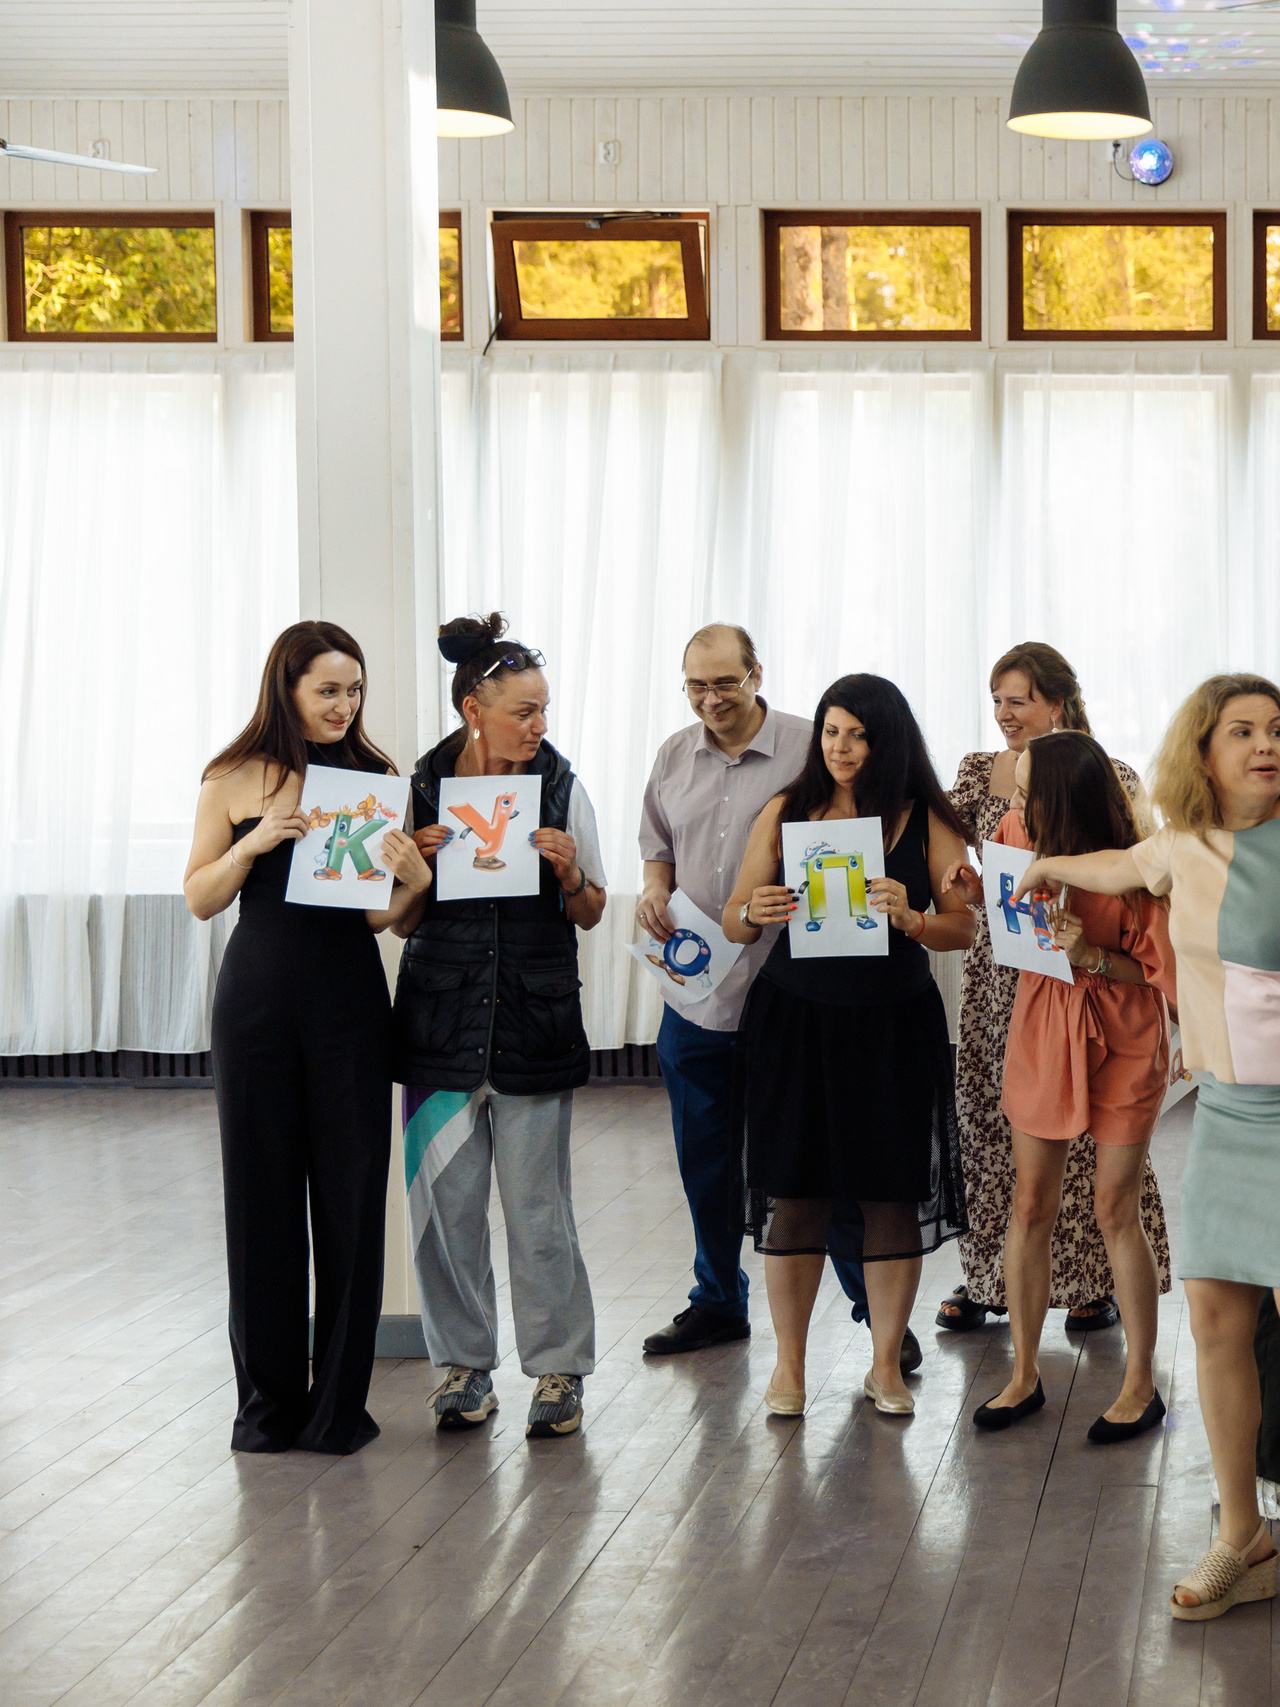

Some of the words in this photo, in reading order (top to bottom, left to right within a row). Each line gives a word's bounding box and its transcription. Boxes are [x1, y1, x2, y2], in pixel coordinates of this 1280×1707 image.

[325, 813, 389, 876] К
[447, 791, 517, 859] У
[805, 851, 869, 921] П
[663, 928, 712, 977] О
